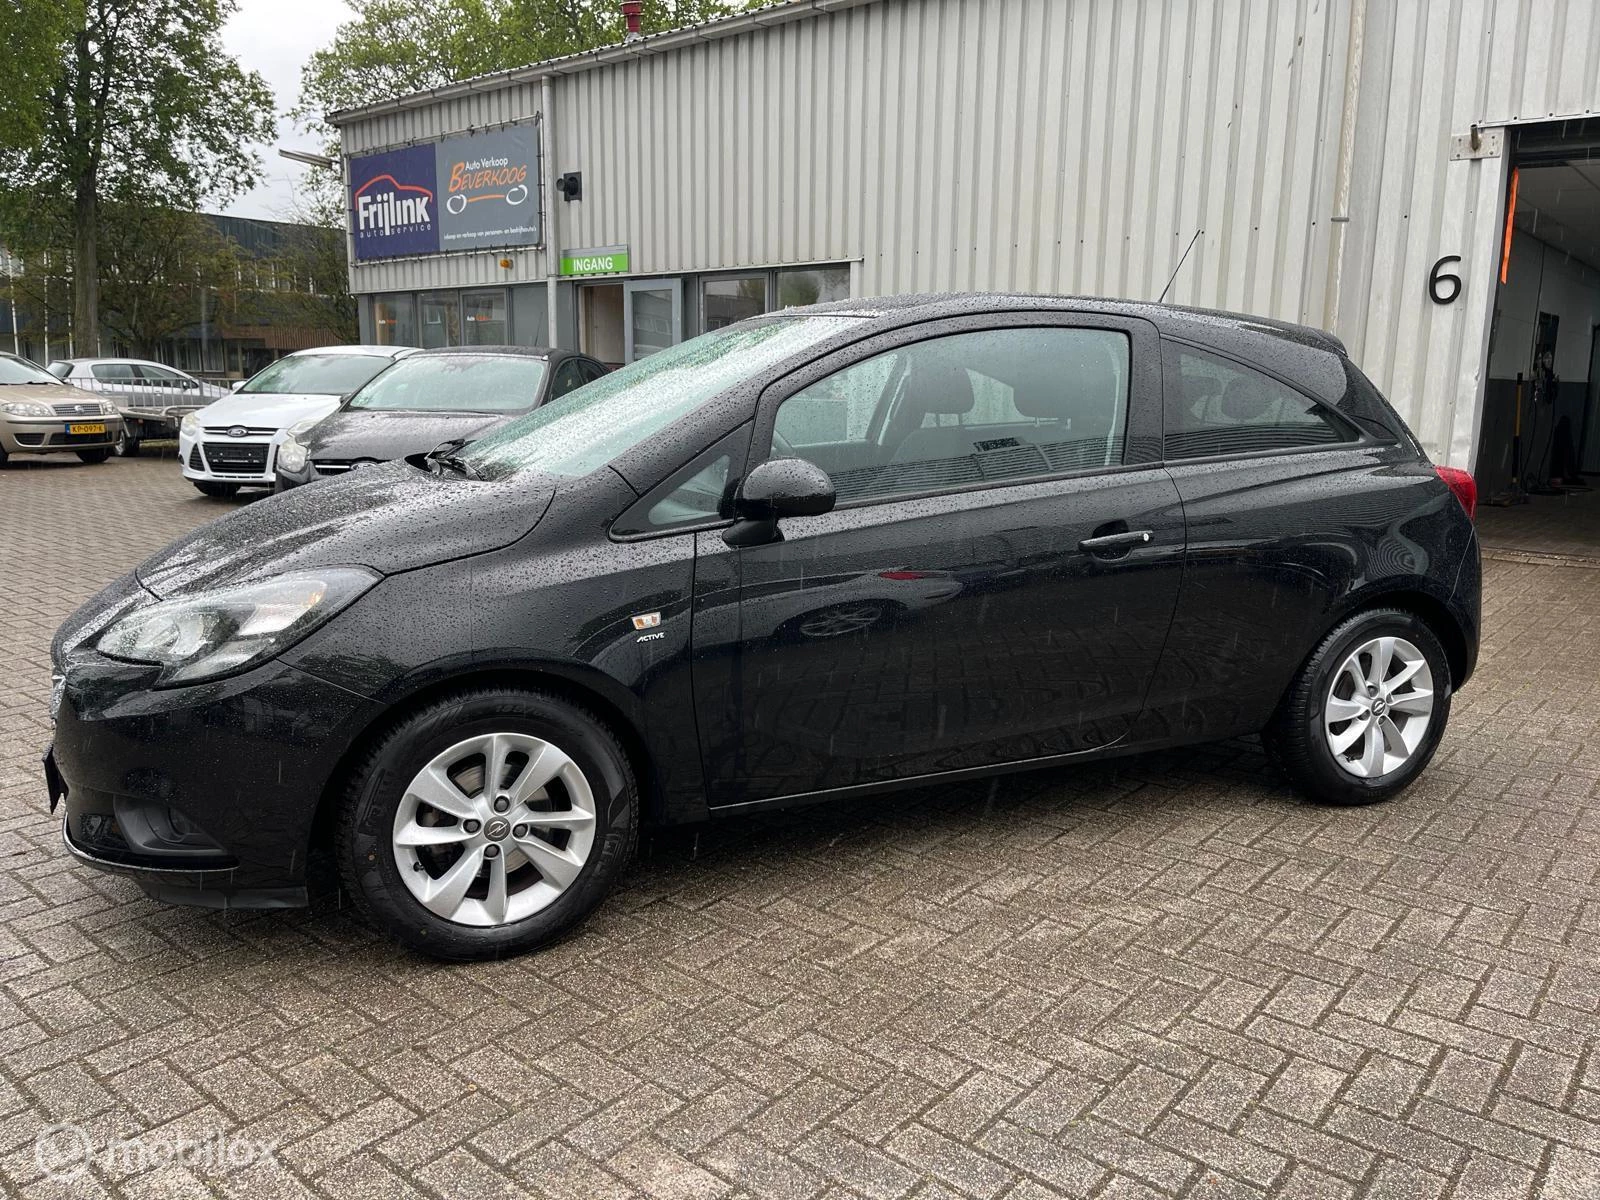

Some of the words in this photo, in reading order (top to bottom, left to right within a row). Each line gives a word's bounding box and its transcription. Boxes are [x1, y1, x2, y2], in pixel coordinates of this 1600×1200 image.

[465, 160, 480, 171] Auto
[481, 156, 508, 168] Verkoop
[573, 257, 613, 272] INGANG
[1429, 255, 1462, 305] 6
[636, 632, 665, 643] ACTIVE
